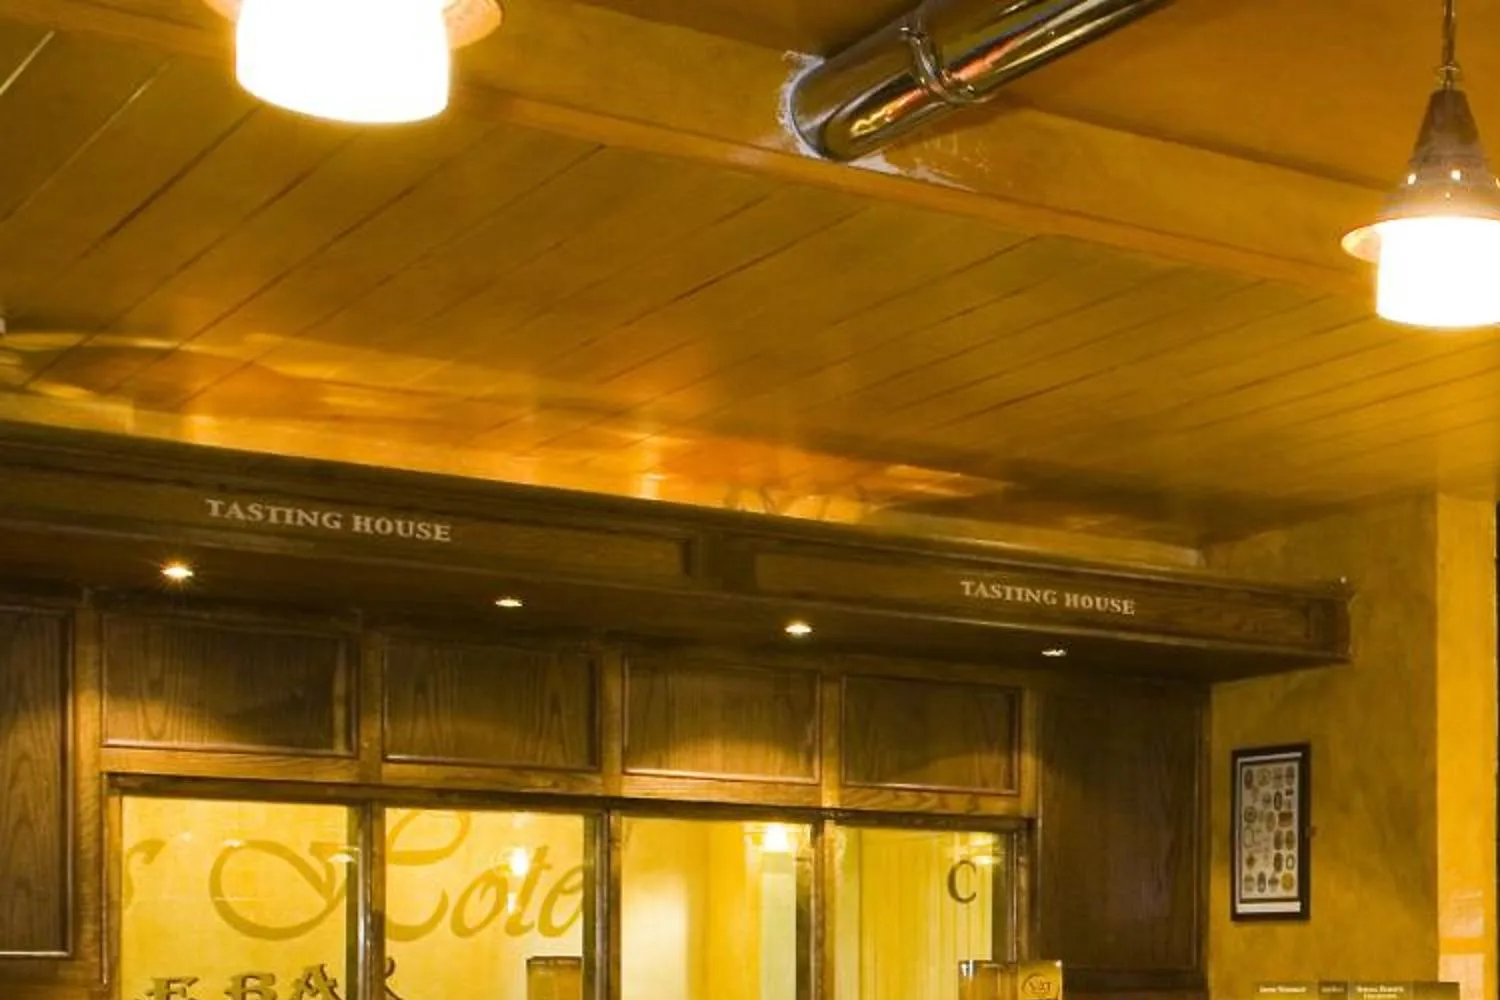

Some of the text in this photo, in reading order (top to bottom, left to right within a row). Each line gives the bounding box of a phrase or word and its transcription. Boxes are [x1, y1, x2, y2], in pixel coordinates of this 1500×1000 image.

[205, 498, 452, 542] TASTING HOUSE
[960, 579, 1136, 616] TASTING HOUSE
